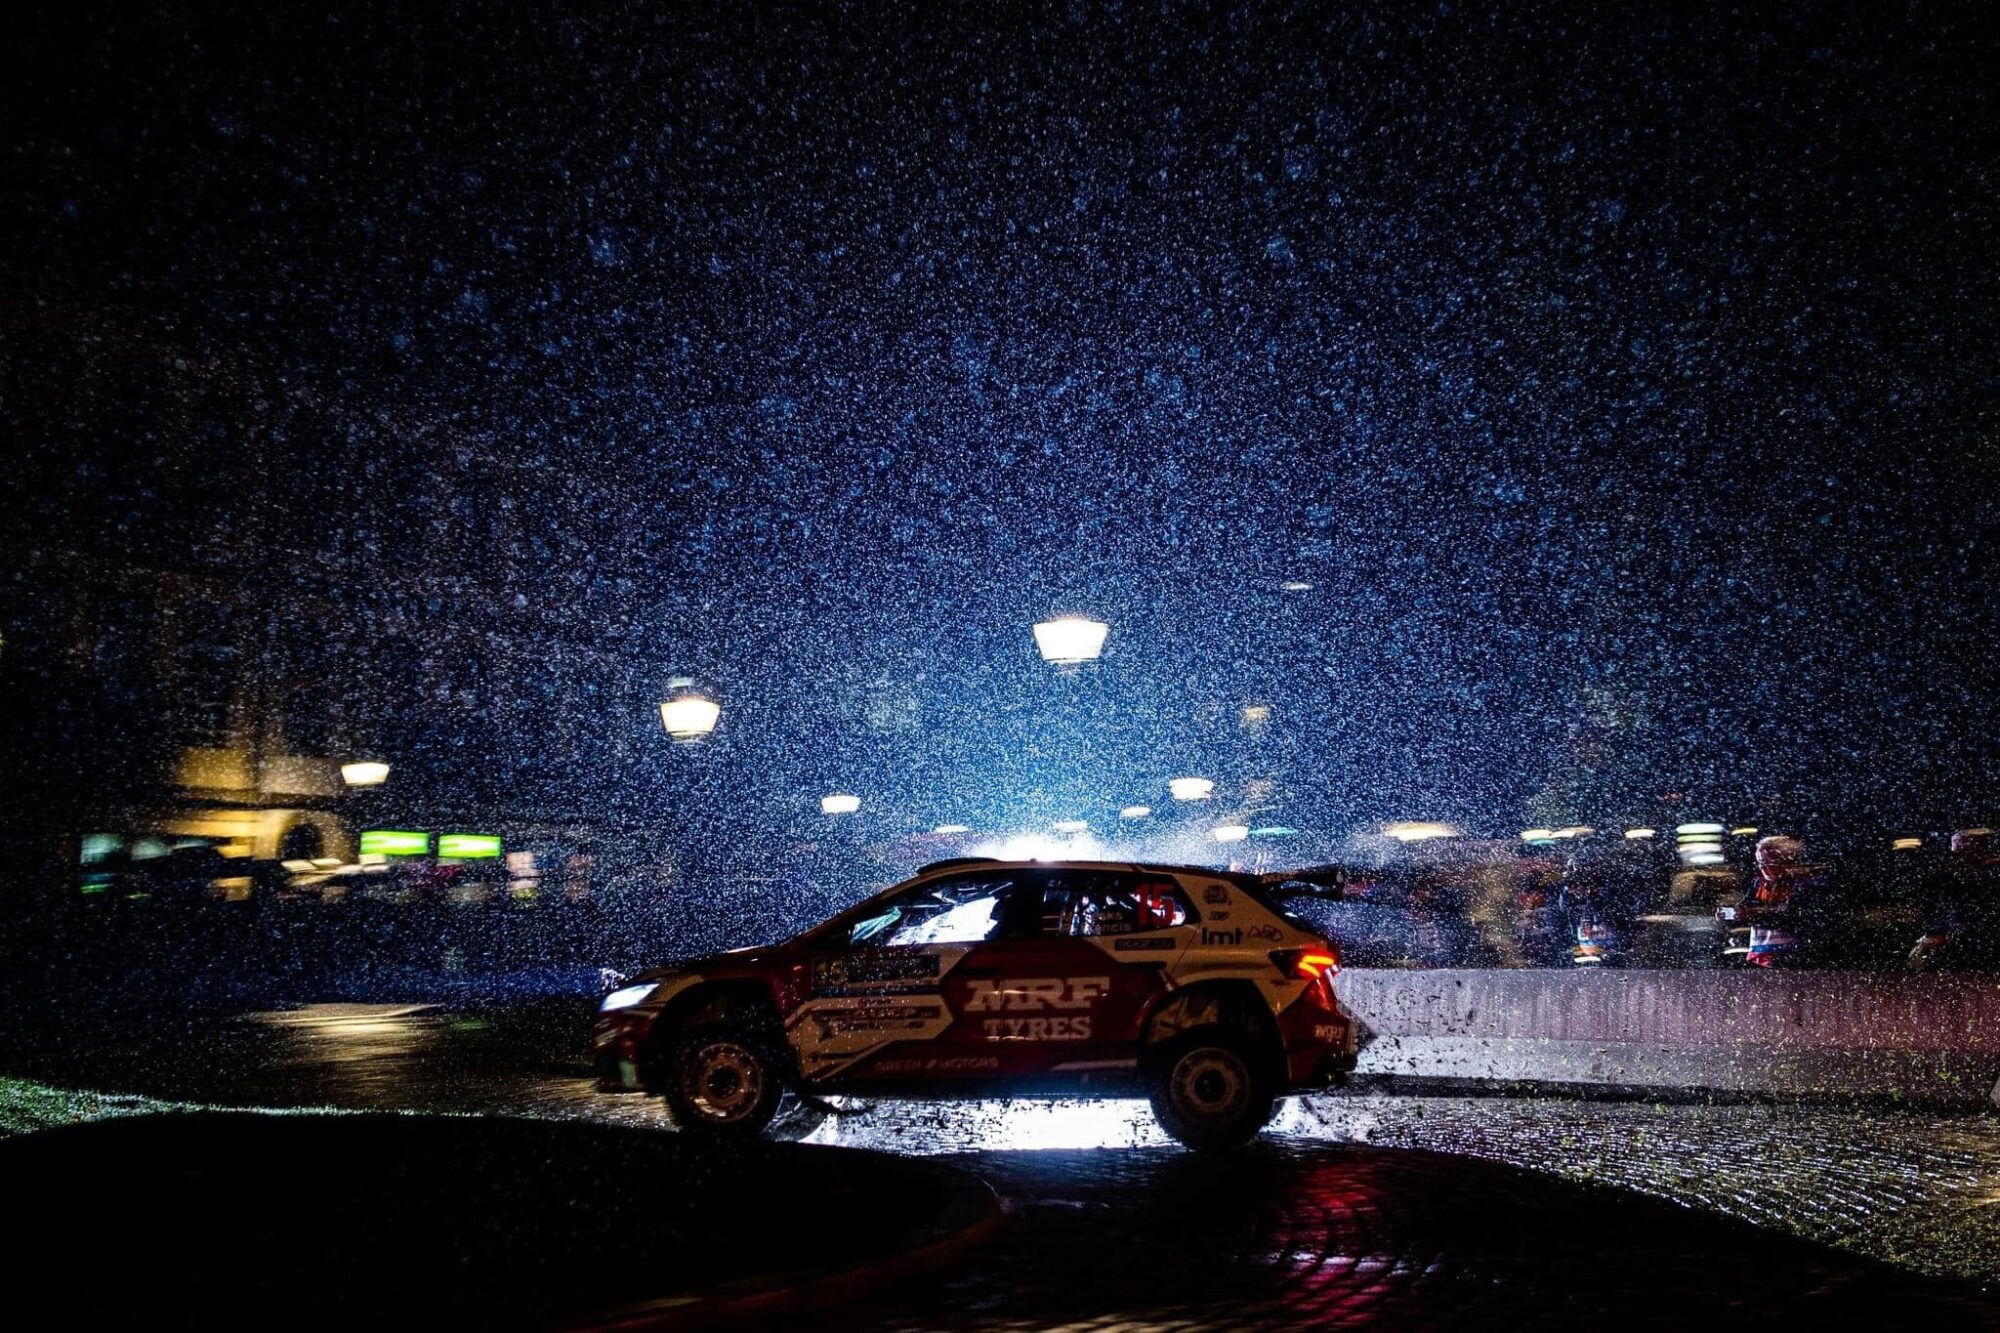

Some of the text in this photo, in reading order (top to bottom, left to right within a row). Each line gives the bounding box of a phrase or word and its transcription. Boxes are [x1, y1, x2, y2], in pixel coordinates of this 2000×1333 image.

[1133, 882, 1175, 928] 15
[1202, 927, 1243, 945] lmt
[963, 976, 1111, 1012] MRF
[984, 1015, 1092, 1042] TYRES
[873, 1055, 998, 1072] GREEN MOTORS
